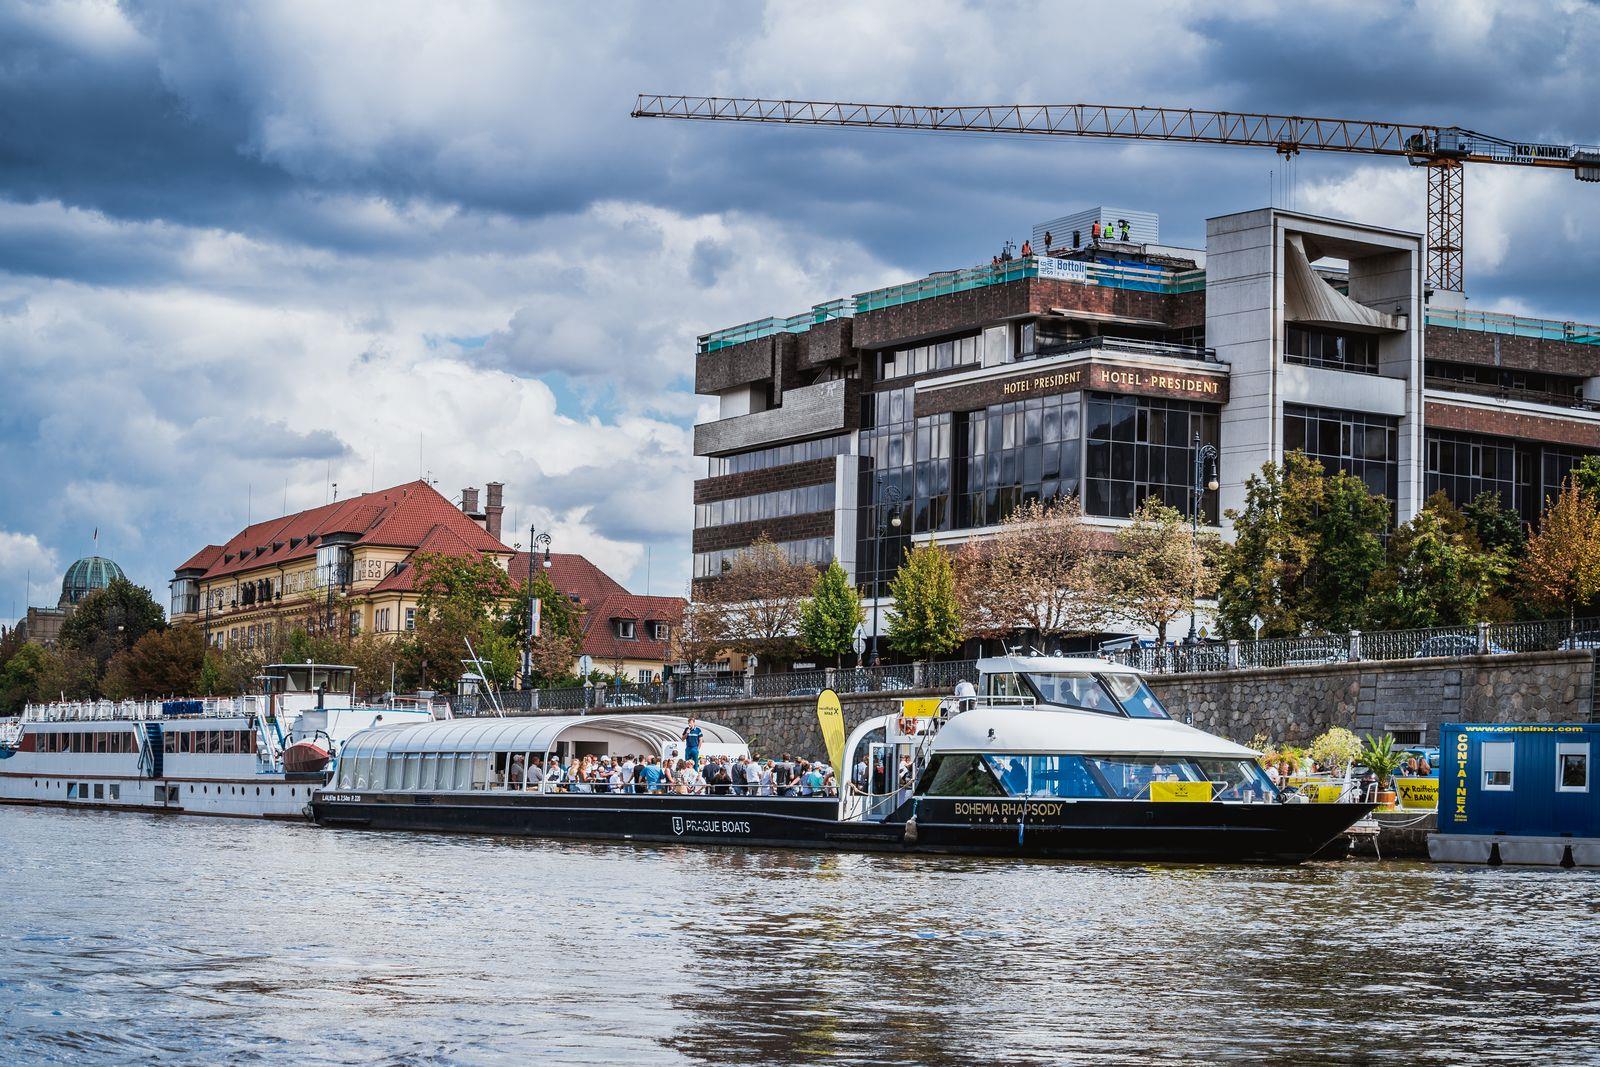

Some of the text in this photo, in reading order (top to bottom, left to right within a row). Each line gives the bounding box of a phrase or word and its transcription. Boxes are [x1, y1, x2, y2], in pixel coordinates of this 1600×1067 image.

[1517, 145, 1568, 158] KRANIMEX
[1057, 260, 1084, 272] Bottoli
[1004, 371, 1081, 394] HOTEL PRESIDENT
[1101, 371, 1219, 394] HOTEL PRESIDENT
[1456, 734, 1467, 813] CONTAINEX
[1414, 793, 1434, 803] BANK
[955, 803, 1063, 816] BOHEMIA RHAPSODY
[686, 820, 751, 833] PRAGUE BOATS
